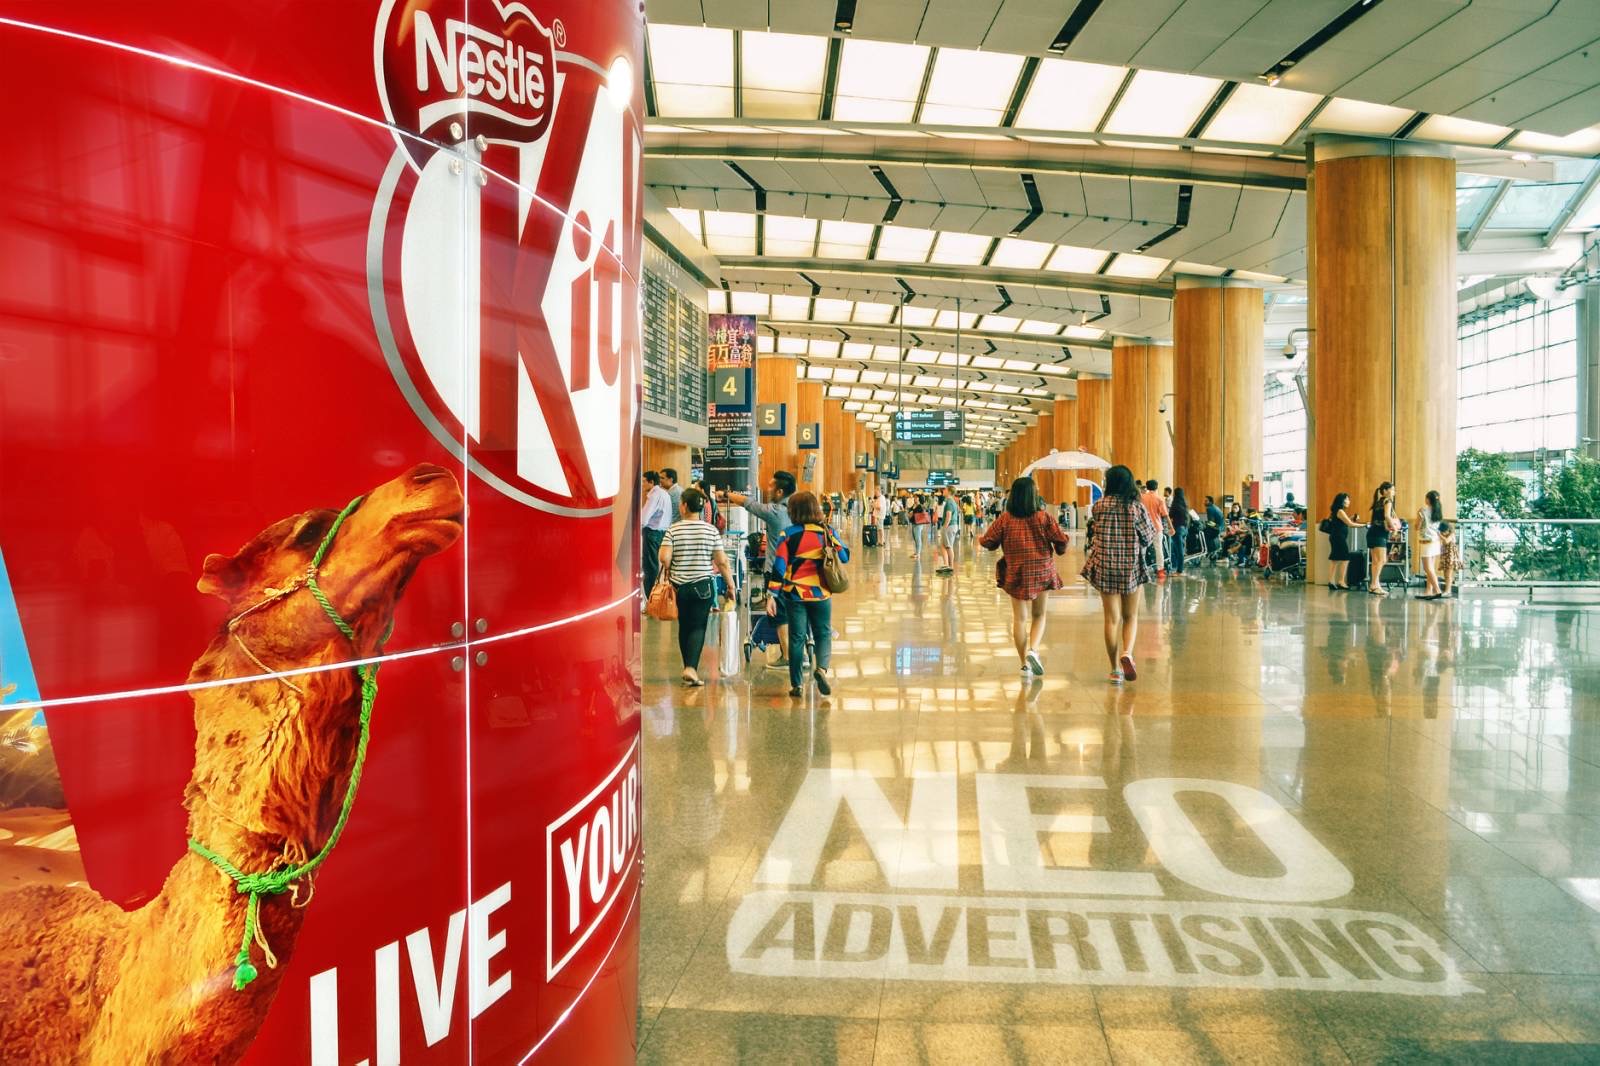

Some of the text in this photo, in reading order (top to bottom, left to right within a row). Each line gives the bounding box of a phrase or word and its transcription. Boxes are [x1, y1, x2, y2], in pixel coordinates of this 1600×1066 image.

[723, 377, 737, 397] 4
[765, 409, 776, 425] 5
[802, 428, 811, 440] 6
[857, 455, 864, 463] 7
[755, 767, 1354, 901] NEO
[310, 763, 637, 1066] LIVE YOUR
[740, 899, 1448, 983] ADVERTISING
